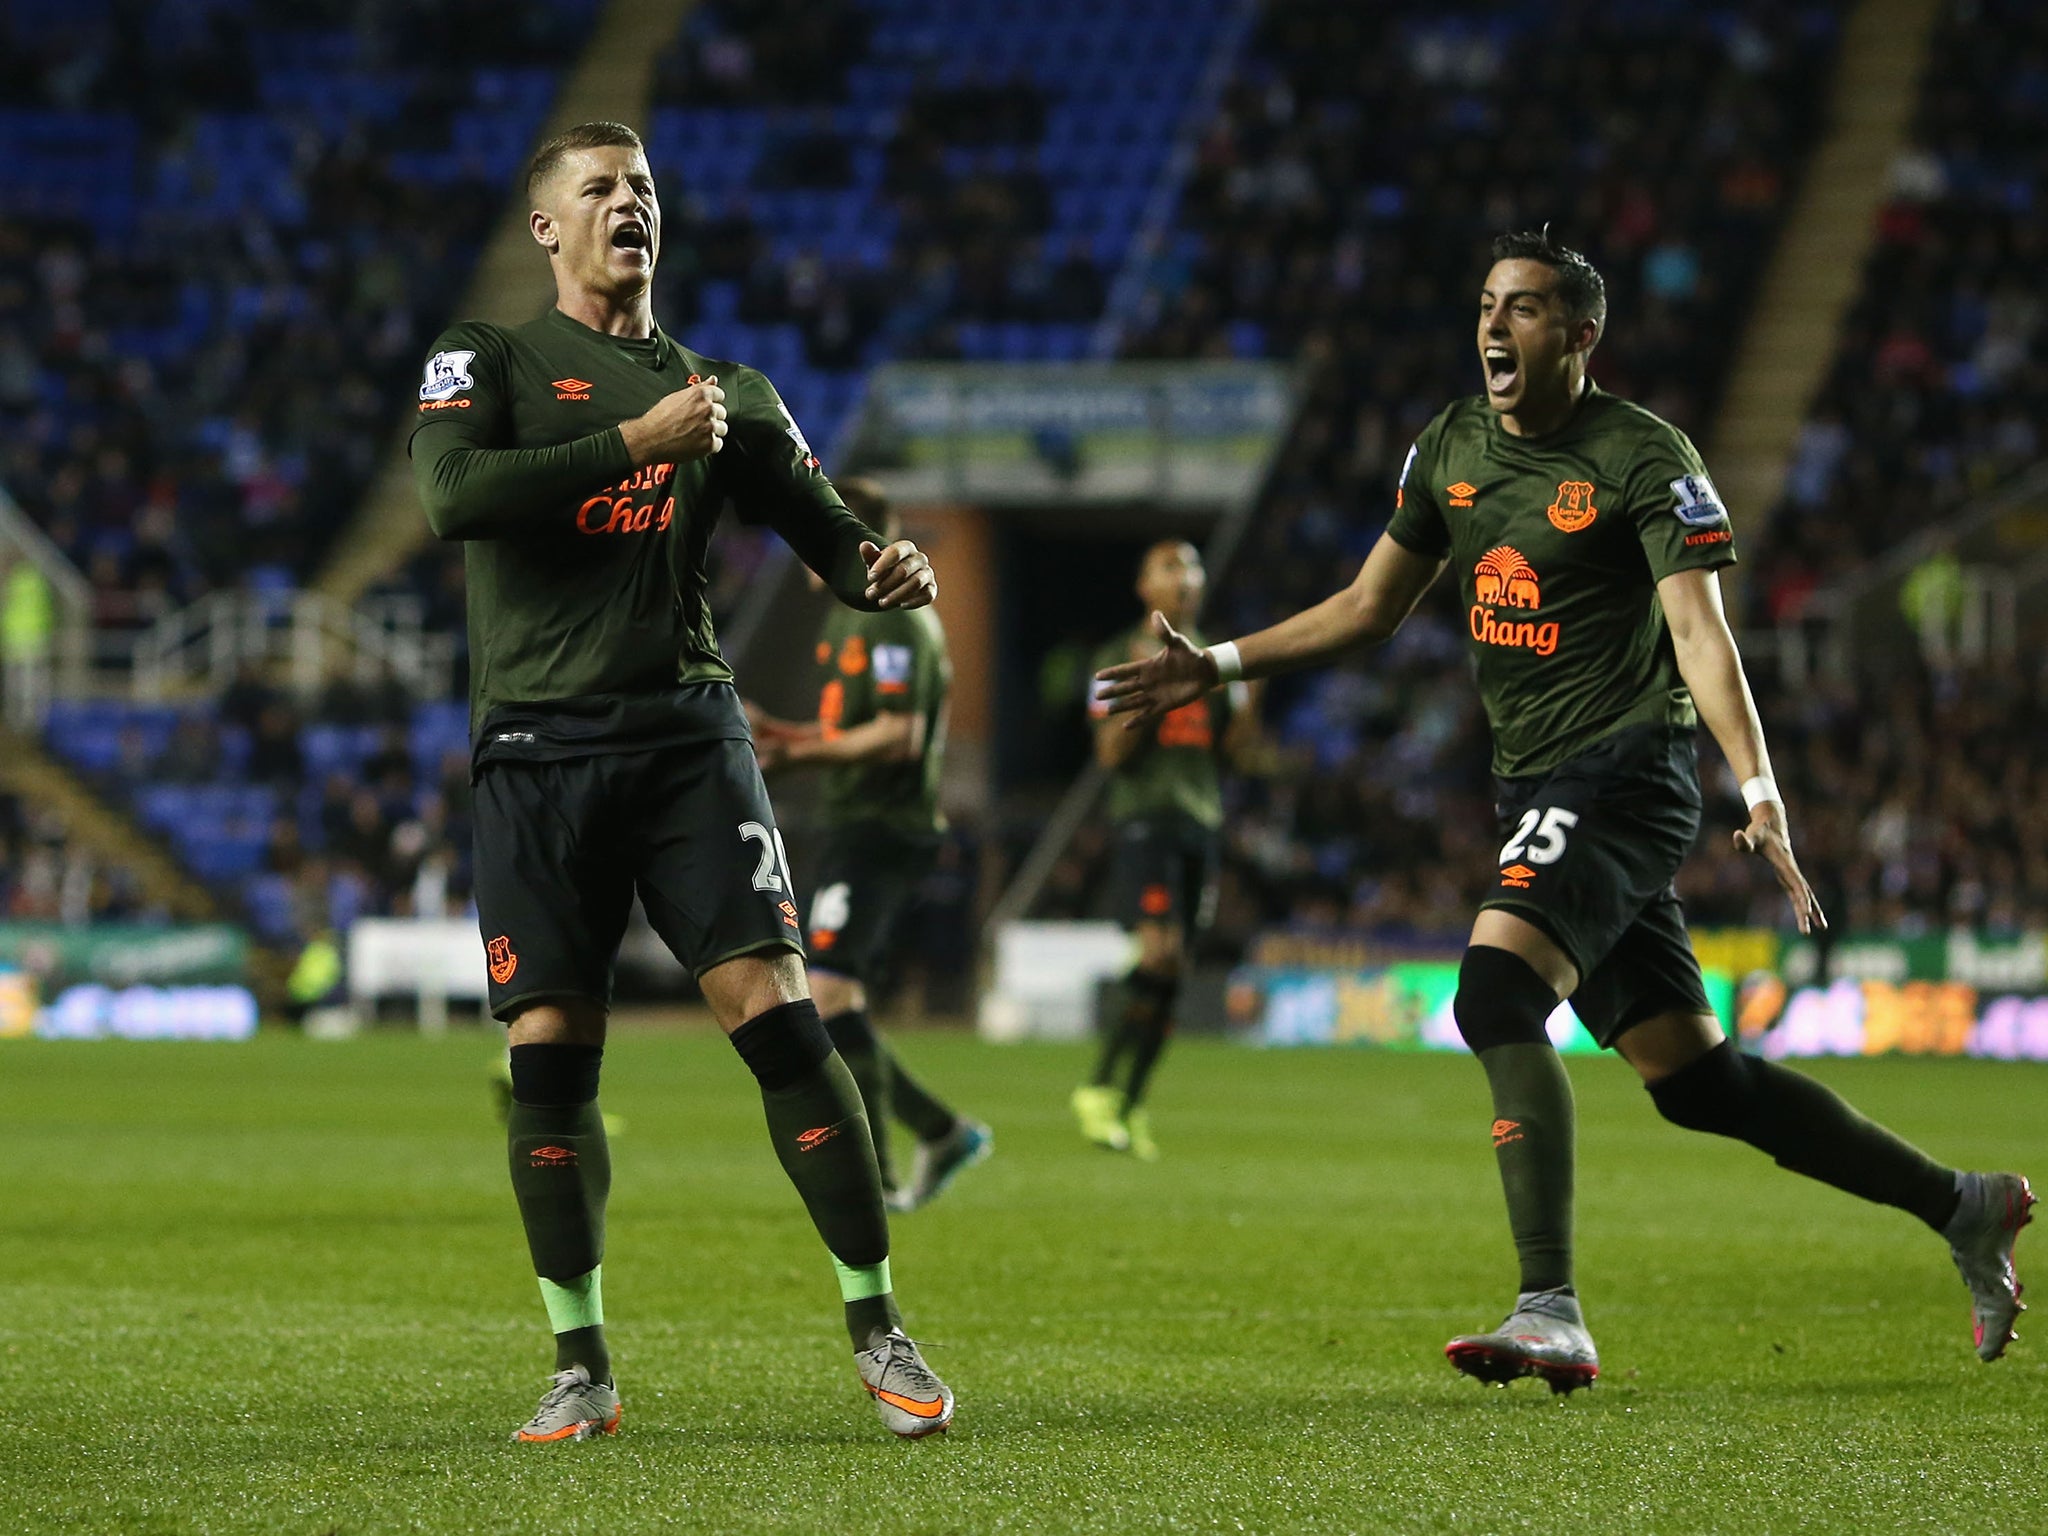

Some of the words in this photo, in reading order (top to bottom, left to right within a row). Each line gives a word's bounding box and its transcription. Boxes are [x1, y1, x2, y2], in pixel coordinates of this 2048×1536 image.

[556, 392, 590, 400] umbro
[576, 496, 676, 534] Chag
[1685, 531, 1731, 546] umbro
[1469, 604, 1560, 656] Chang
[1499, 806, 1579, 866] 25
[1501, 877, 1530, 889] umbro
